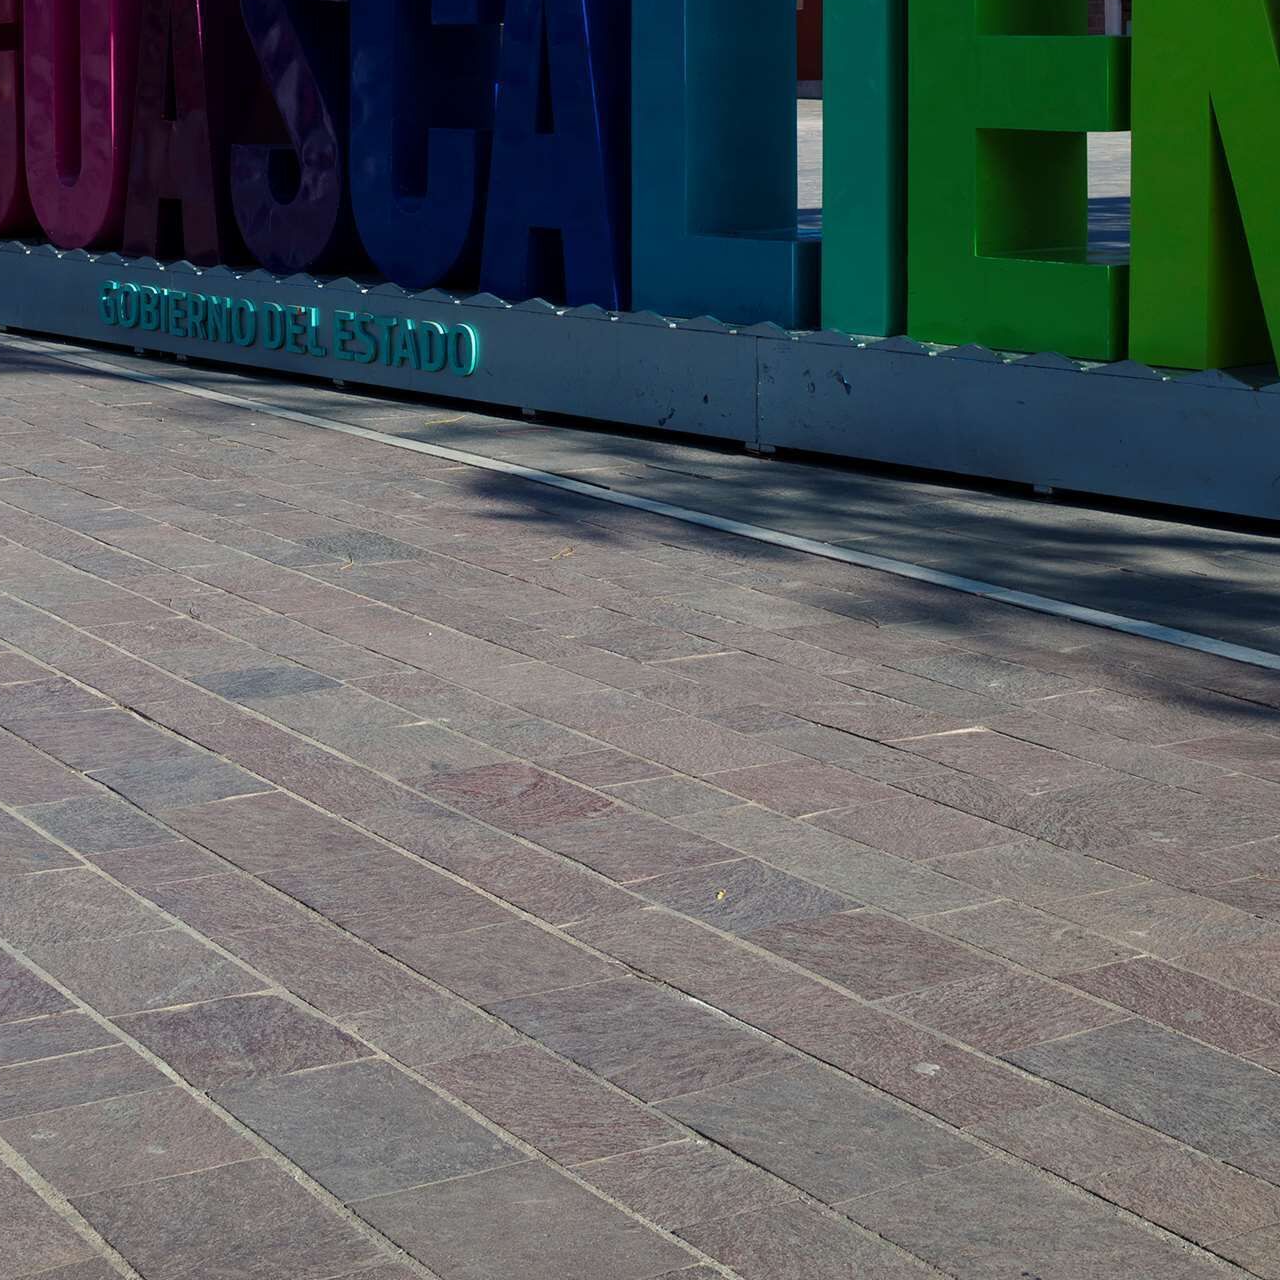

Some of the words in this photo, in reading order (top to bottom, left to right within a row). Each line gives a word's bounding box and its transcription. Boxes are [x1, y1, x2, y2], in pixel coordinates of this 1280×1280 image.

[99, 280, 258, 347] GOBIERNO
[263, 300, 327, 358] DEL
[332, 309, 481, 377] ESTADO
